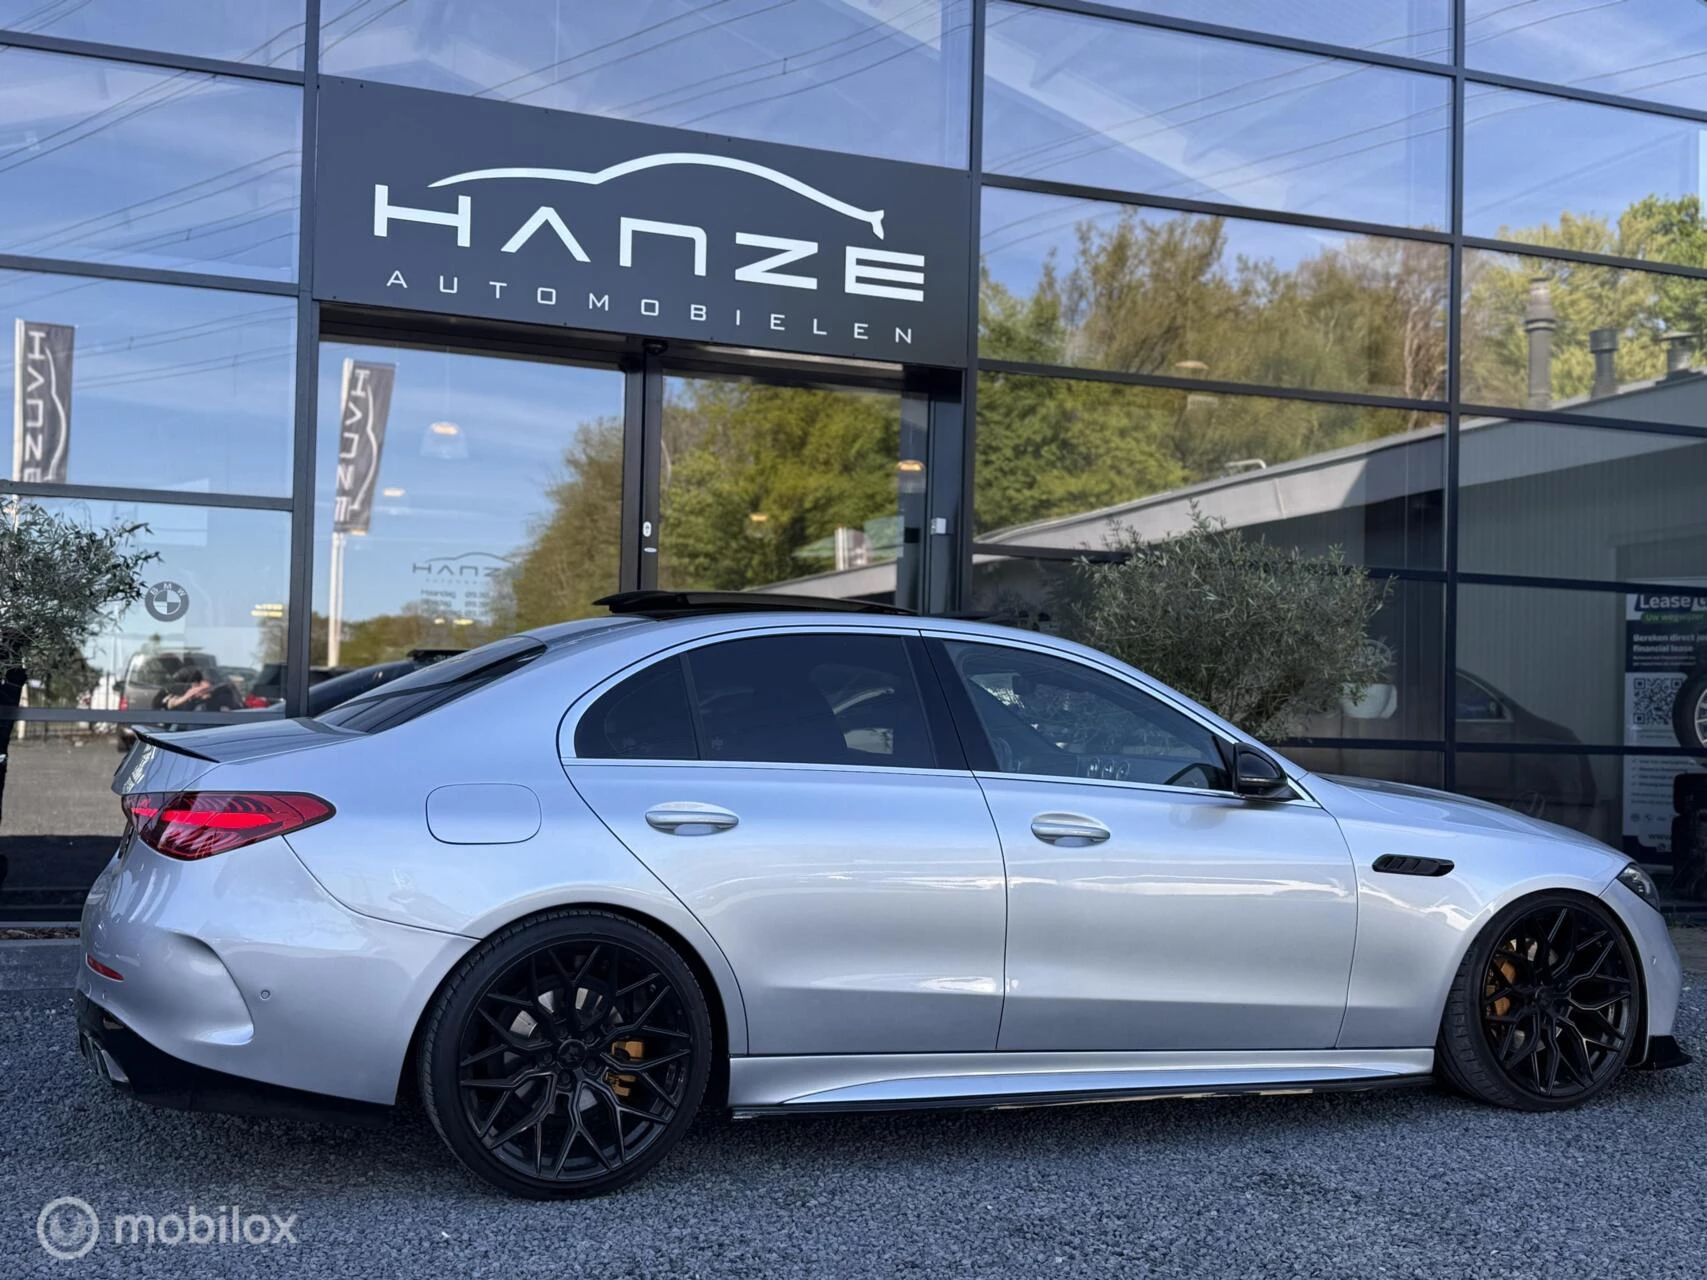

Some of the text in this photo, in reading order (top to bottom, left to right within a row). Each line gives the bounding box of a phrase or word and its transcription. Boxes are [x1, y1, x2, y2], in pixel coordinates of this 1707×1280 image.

[373, 183, 925, 302] HANZE
[386, 269, 913, 344] AUTOMOBIELEN
[1640, 594, 1692, 608] Lease
